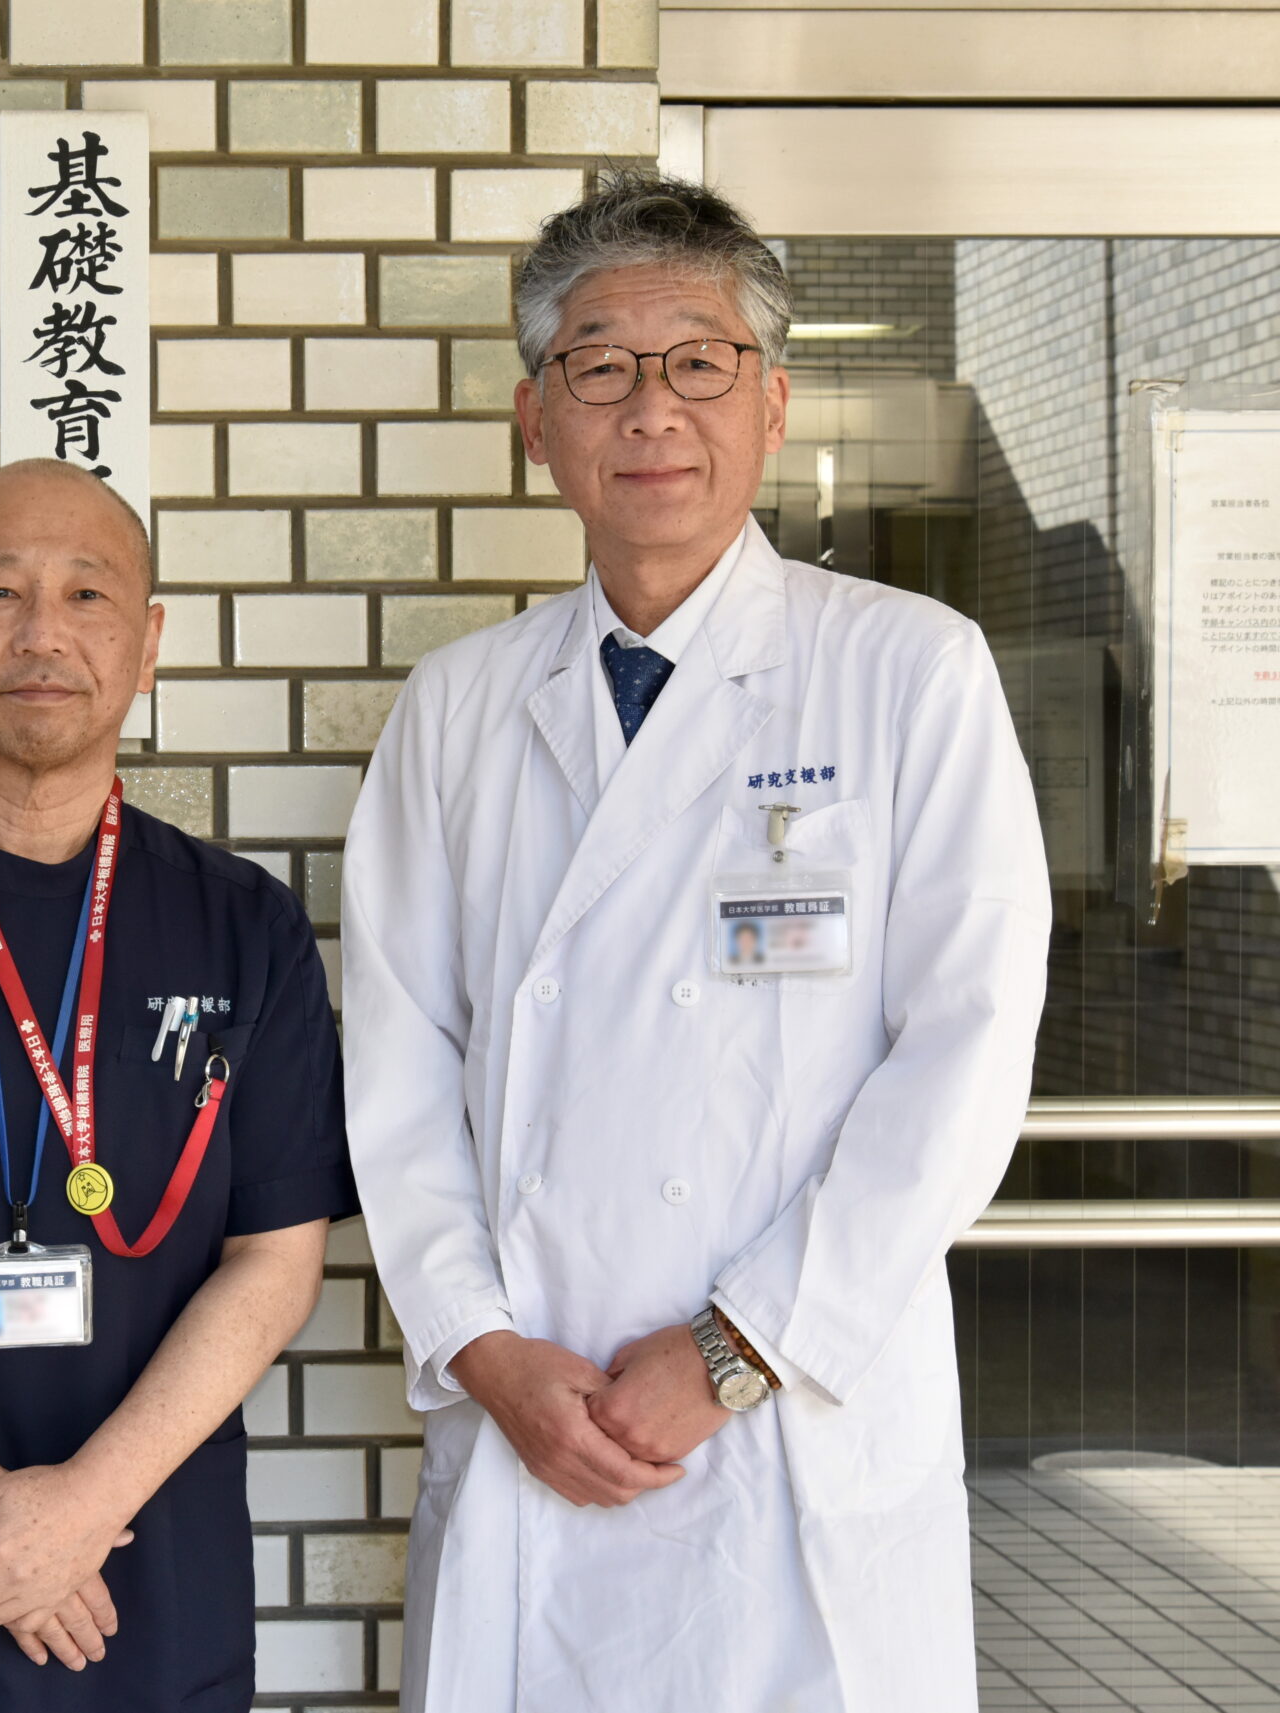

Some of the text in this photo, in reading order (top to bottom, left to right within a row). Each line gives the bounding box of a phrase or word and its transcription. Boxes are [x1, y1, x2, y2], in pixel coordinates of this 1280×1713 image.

[23, 131, 129, 477] 基礎教育
[1210, 645, 1280, 653] アポイントの時間
[747, 765, 836, 789] 研究支援部
[784, 901, 830, 914] 教職員証
[147, 995, 231, 1014] 研援部
[78, 1014, 94, 1052] 医療用
[20, 1275, 65, 1288] 教職員証
